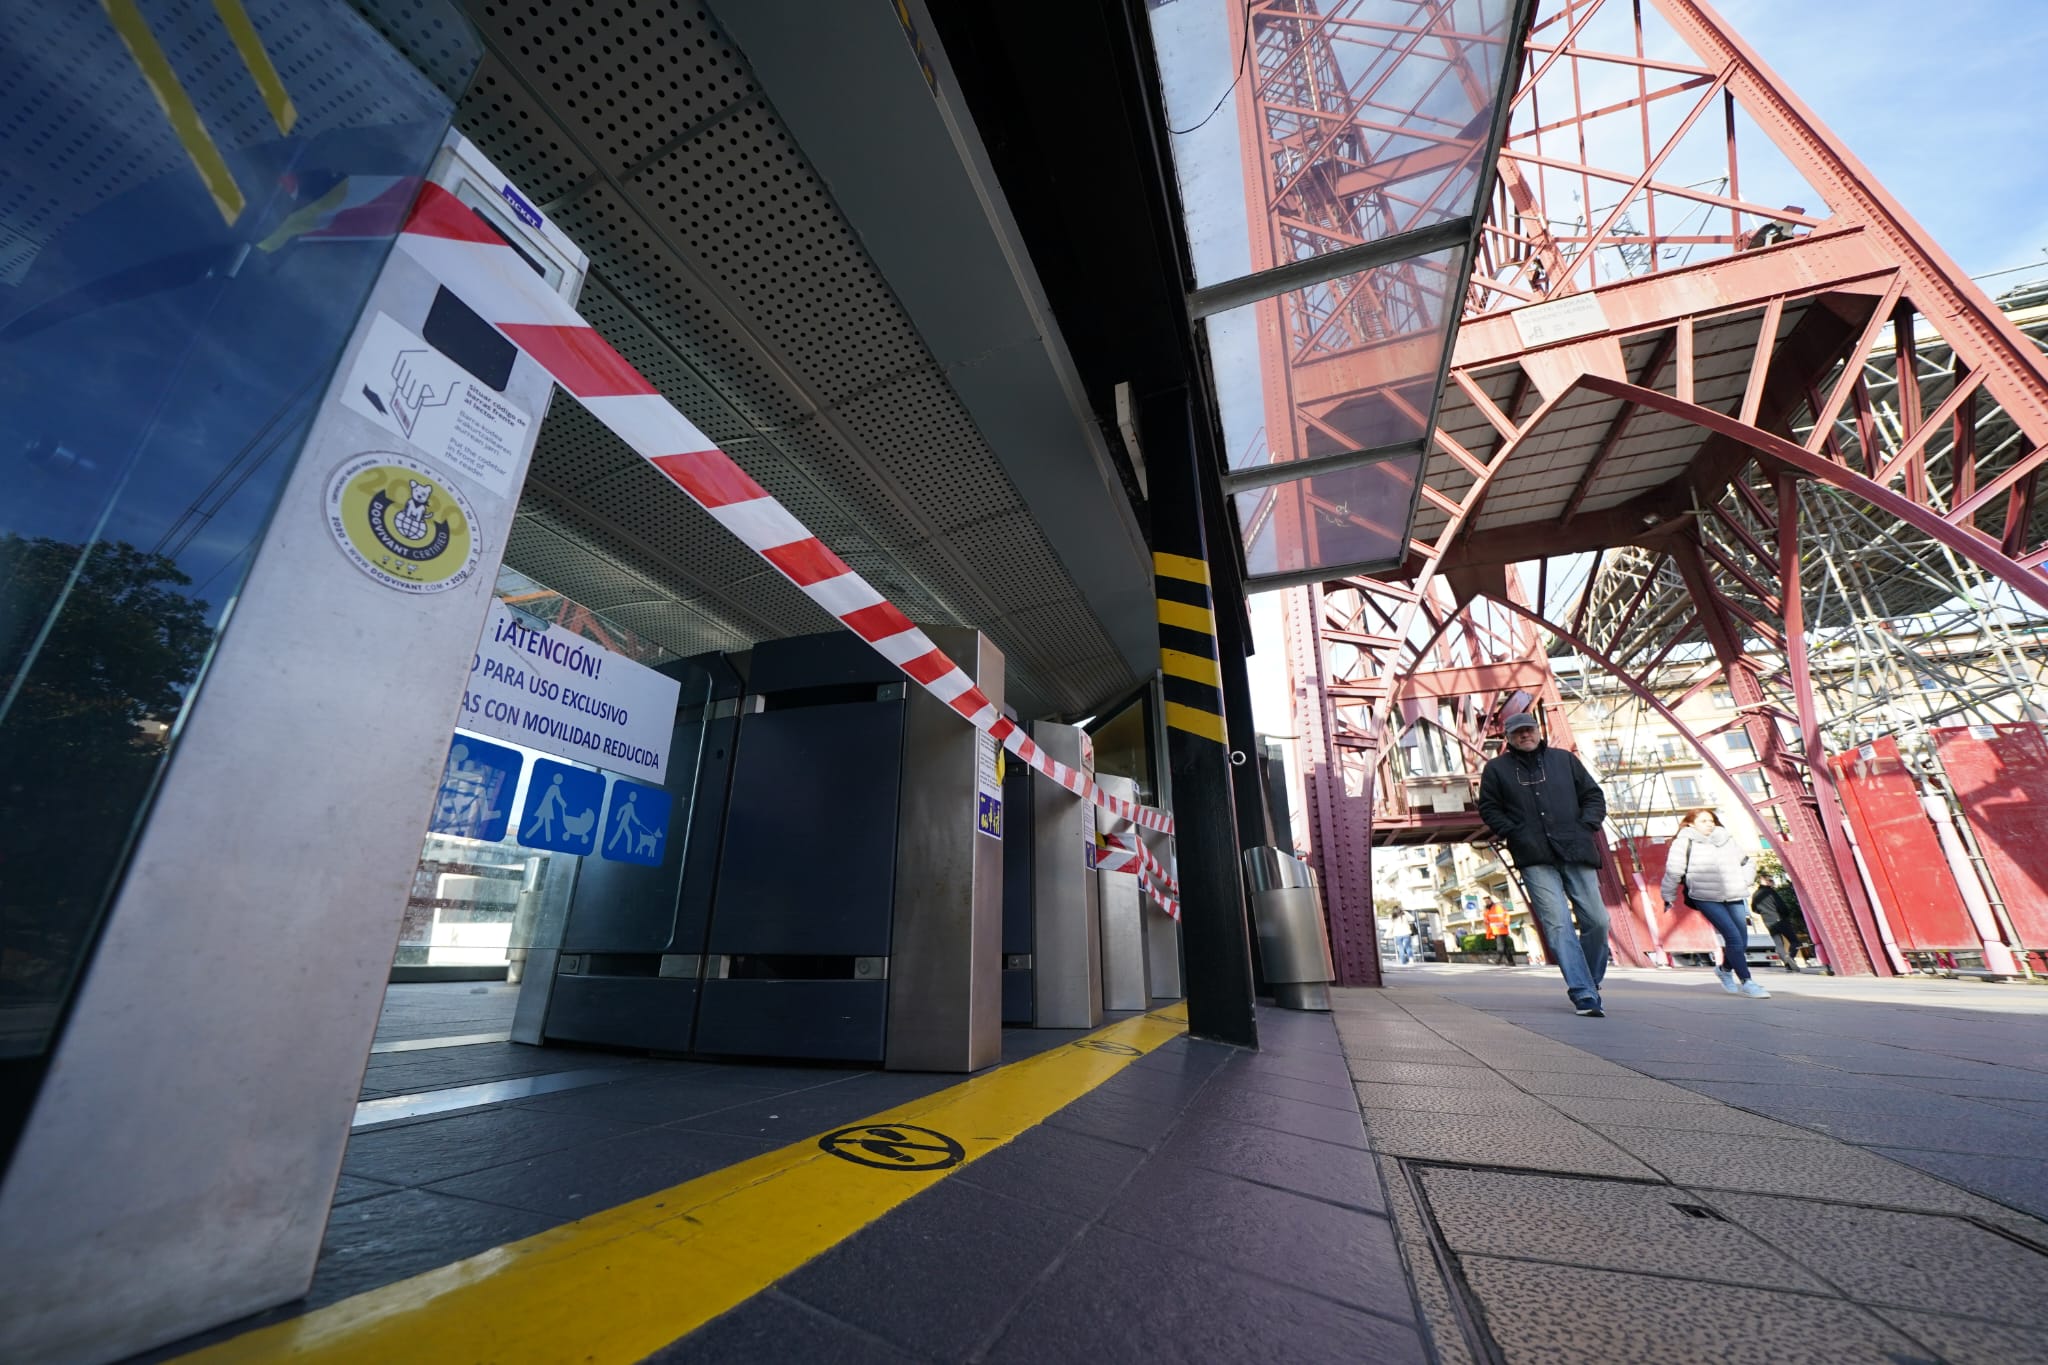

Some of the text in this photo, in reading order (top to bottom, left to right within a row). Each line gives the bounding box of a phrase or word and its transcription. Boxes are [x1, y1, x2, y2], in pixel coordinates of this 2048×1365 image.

[506, 193, 537, 228] TICKET
[466, 390, 515, 427] barras frente
[469, 384, 526, 427] Situar código de
[473, 402, 496, 423] lector.
[445, 451, 458, 462] the
[450, 437, 463, 448] Put
[464, 446, 477, 457] the
[456, 449, 474, 464] front
[476, 462, 485, 470] of
[332, 516, 346, 538] 2020
[370, 502, 448, 560] DOGVIVANT CERTIFIED
[494, 618, 602, 680] ¡ATENCIÓN!
[483, 658, 524, 690] PARA
[529, 675, 559, 701] USO
[562, 688, 628, 726] EXCLUSIVO
[484, 698, 520, 726] CON
[522, 711, 600, 750] MOVILIDAD
[602, 738, 660, 770] REDUCIDA
